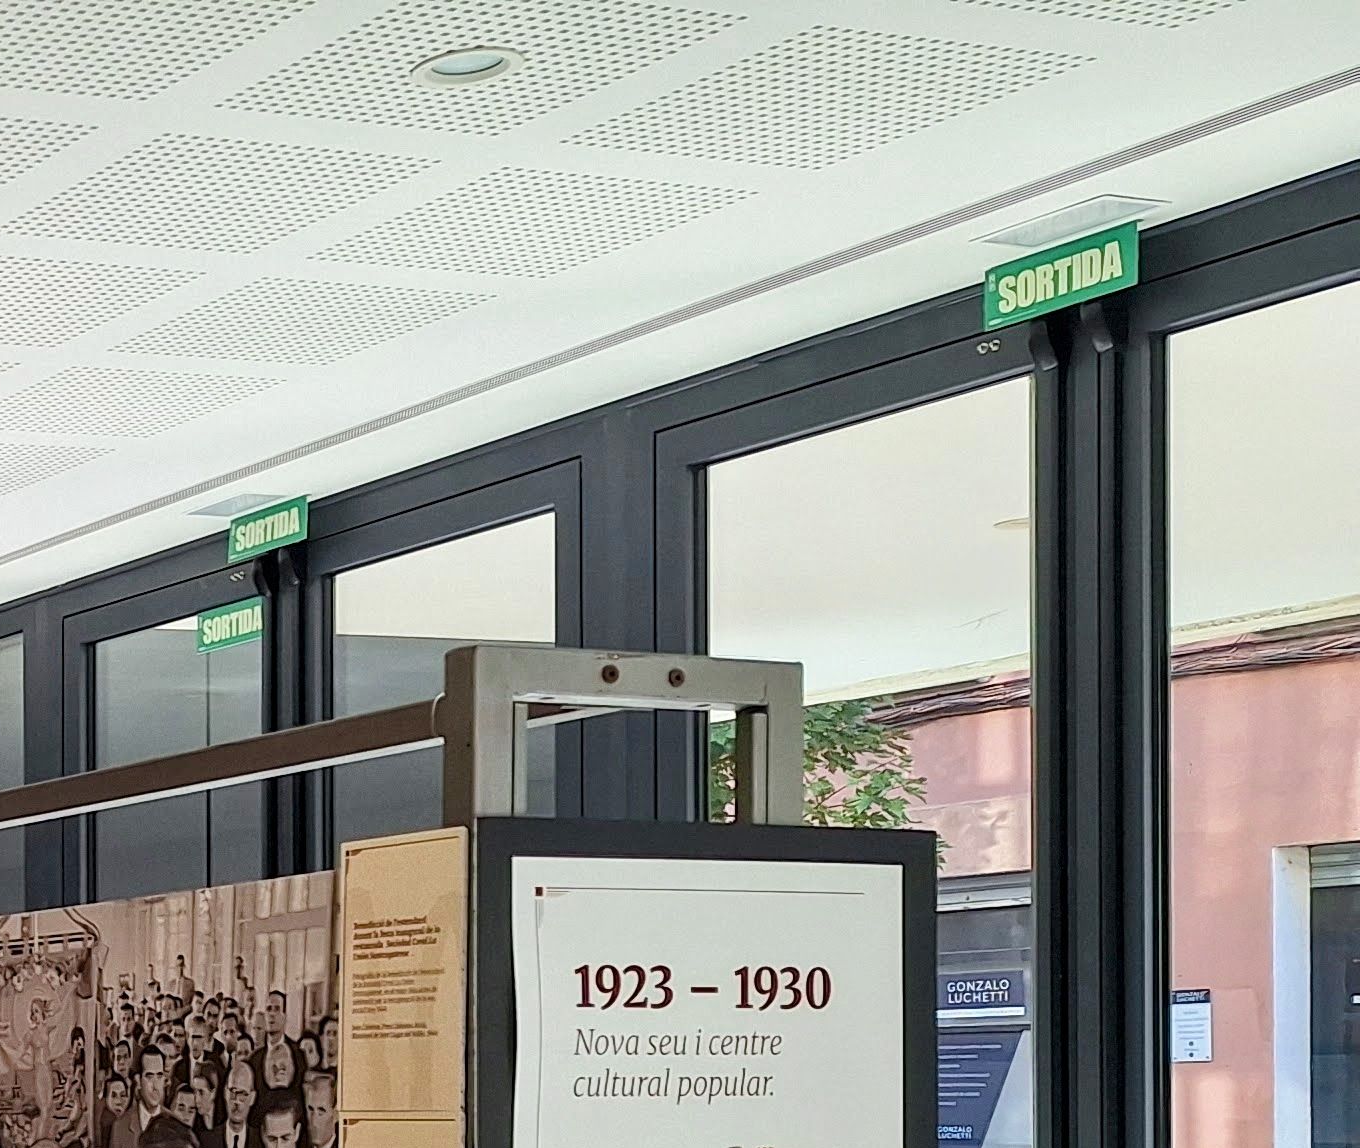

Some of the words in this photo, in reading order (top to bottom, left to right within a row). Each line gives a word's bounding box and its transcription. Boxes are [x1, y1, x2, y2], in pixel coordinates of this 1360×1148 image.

[998, 241, 1123, 314] SORTIDA
[235, 506, 300, 552] SORTIDA
[203, 605, 263, 645] SORTIDA
[574, 964, 674, 1009] 1923
[734, 966, 832, 1010] 1930
[947, 979, 1010, 992] GONZALO
[948, 991, 1008, 1004] LUCHETTI
[574, 1029, 639, 1056] Nova
[647, 1033, 686, 1056] seu
[694, 1030, 702, 1055] i
[709, 1034, 782, 1056] centre
[573, 1068, 669, 1097] cultural
[677, 1068, 774, 1105] popular.
